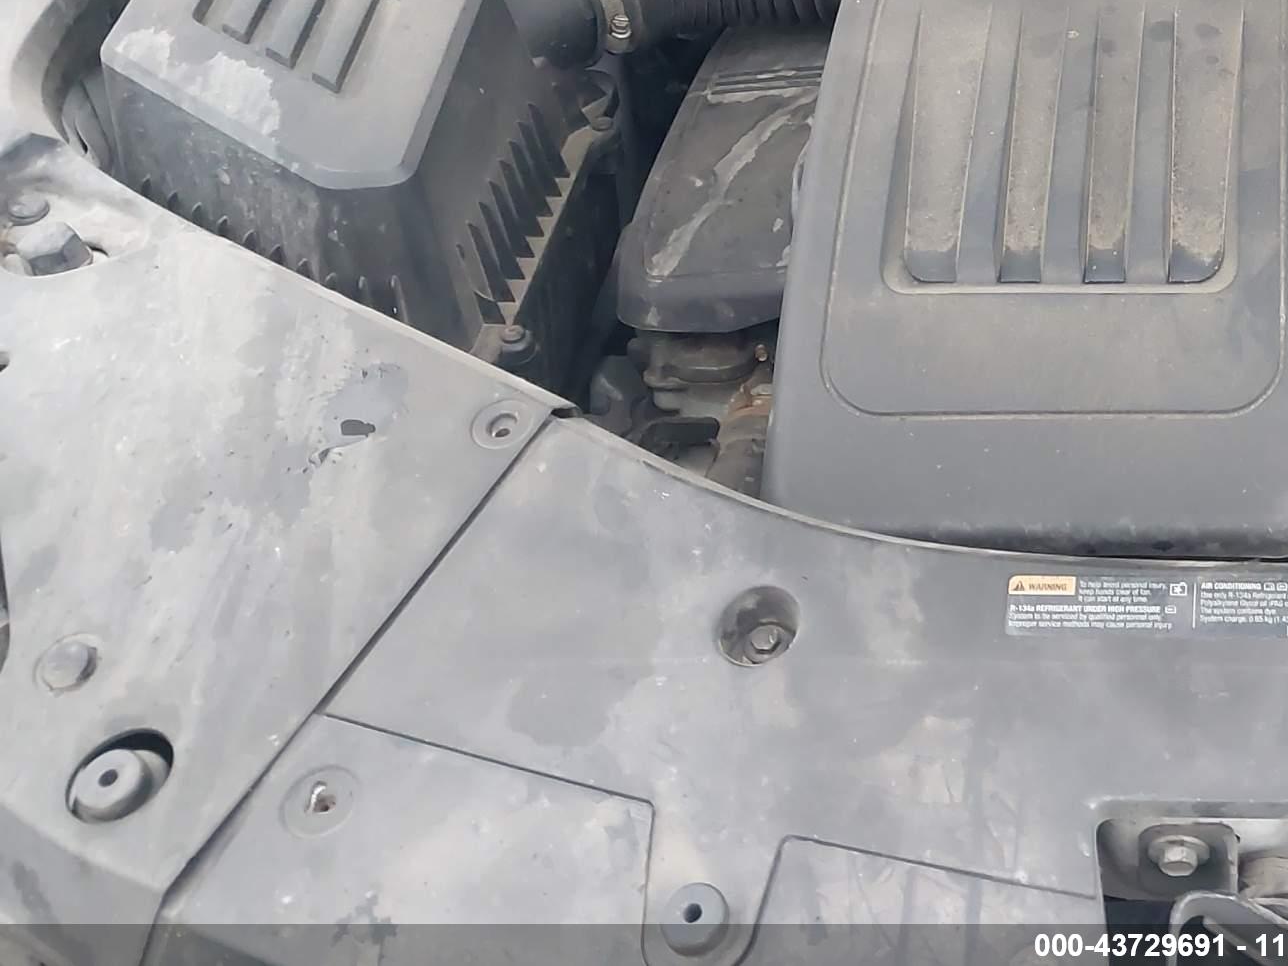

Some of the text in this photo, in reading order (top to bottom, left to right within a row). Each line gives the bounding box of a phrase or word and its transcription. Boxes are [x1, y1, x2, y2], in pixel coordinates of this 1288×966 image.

[1028, 583, 1068, 591] WARNING
[1201, 582, 1262, 590] AIR CONDITIONING
[1126, 605, 1160, 613] PRESSURE
